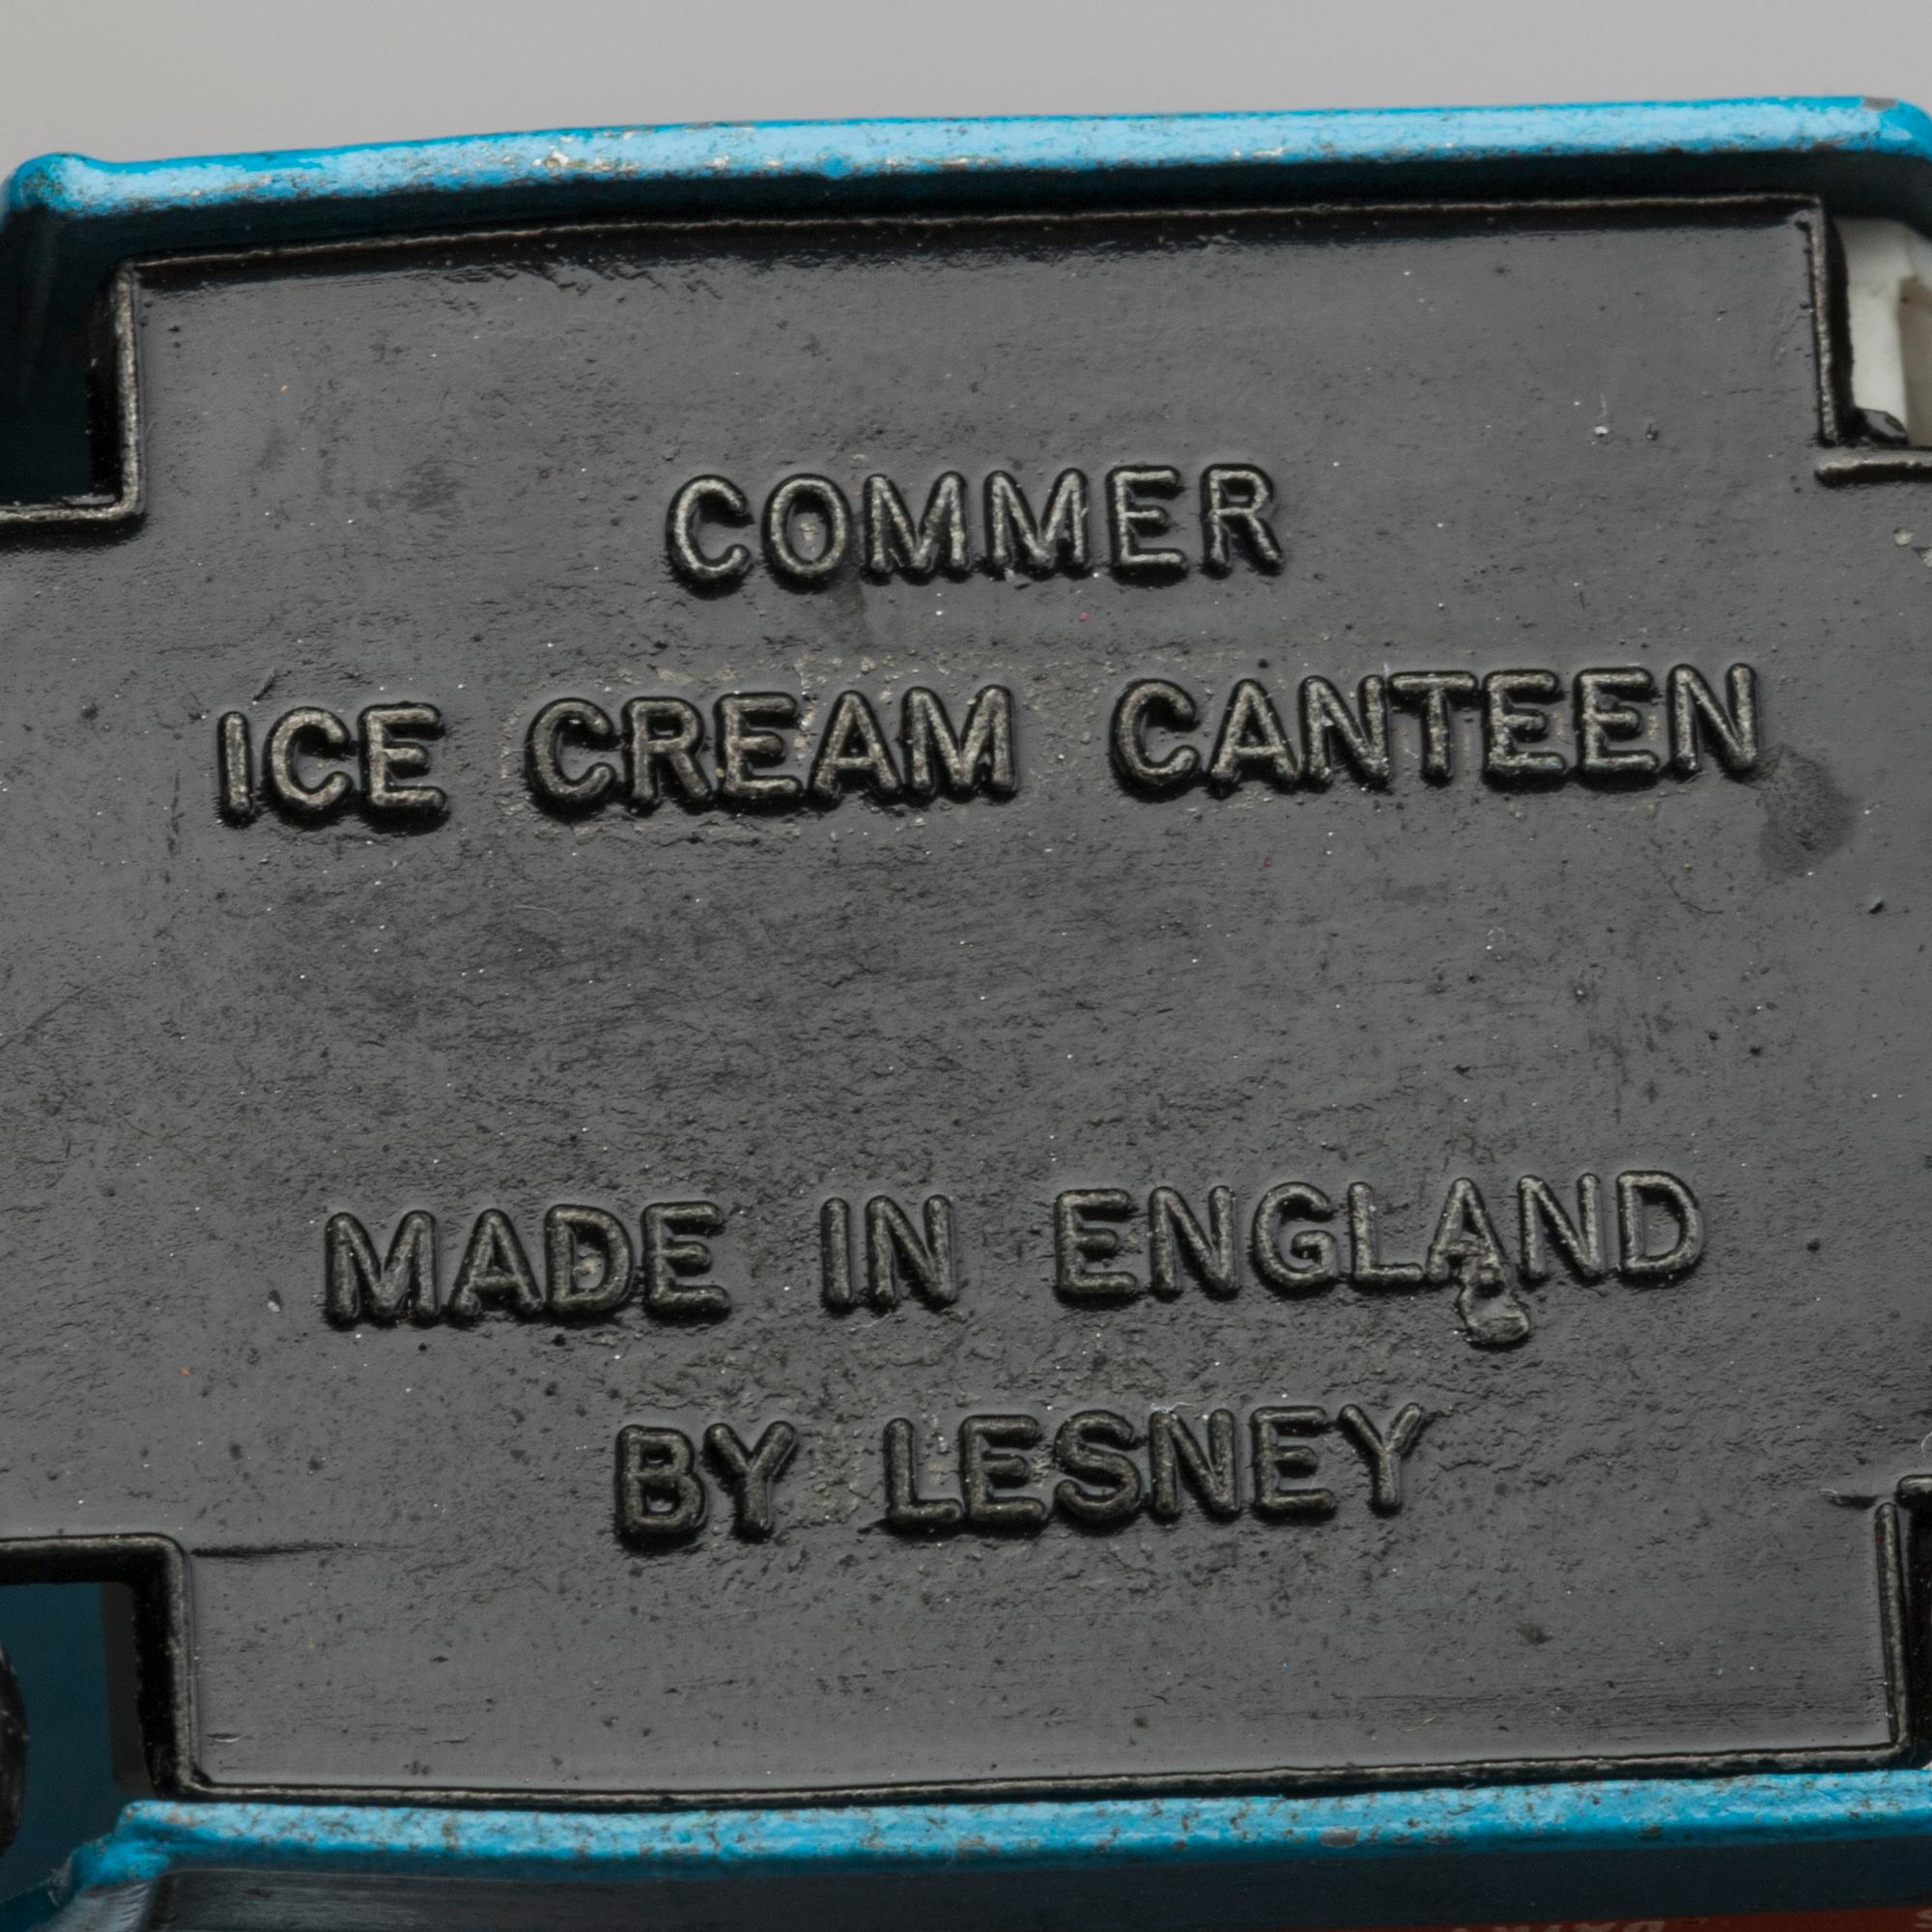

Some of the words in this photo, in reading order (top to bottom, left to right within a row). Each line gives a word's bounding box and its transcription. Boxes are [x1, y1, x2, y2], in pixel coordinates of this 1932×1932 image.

[667, 464, 1283, 592] COMMER
[217, 700, 448, 827] ICE
[525, 685, 1019, 817] CREAM
[1108, 663, 1761, 796] CANTEEN
[325, 1200, 731, 1326] MADE
[820, 1194, 957, 1314] IN
[1054, 1170, 1704, 1300] ENGLAND
[614, 1419, 798, 1549] BY
[883, 1403, 1428, 1535] LESNEY
